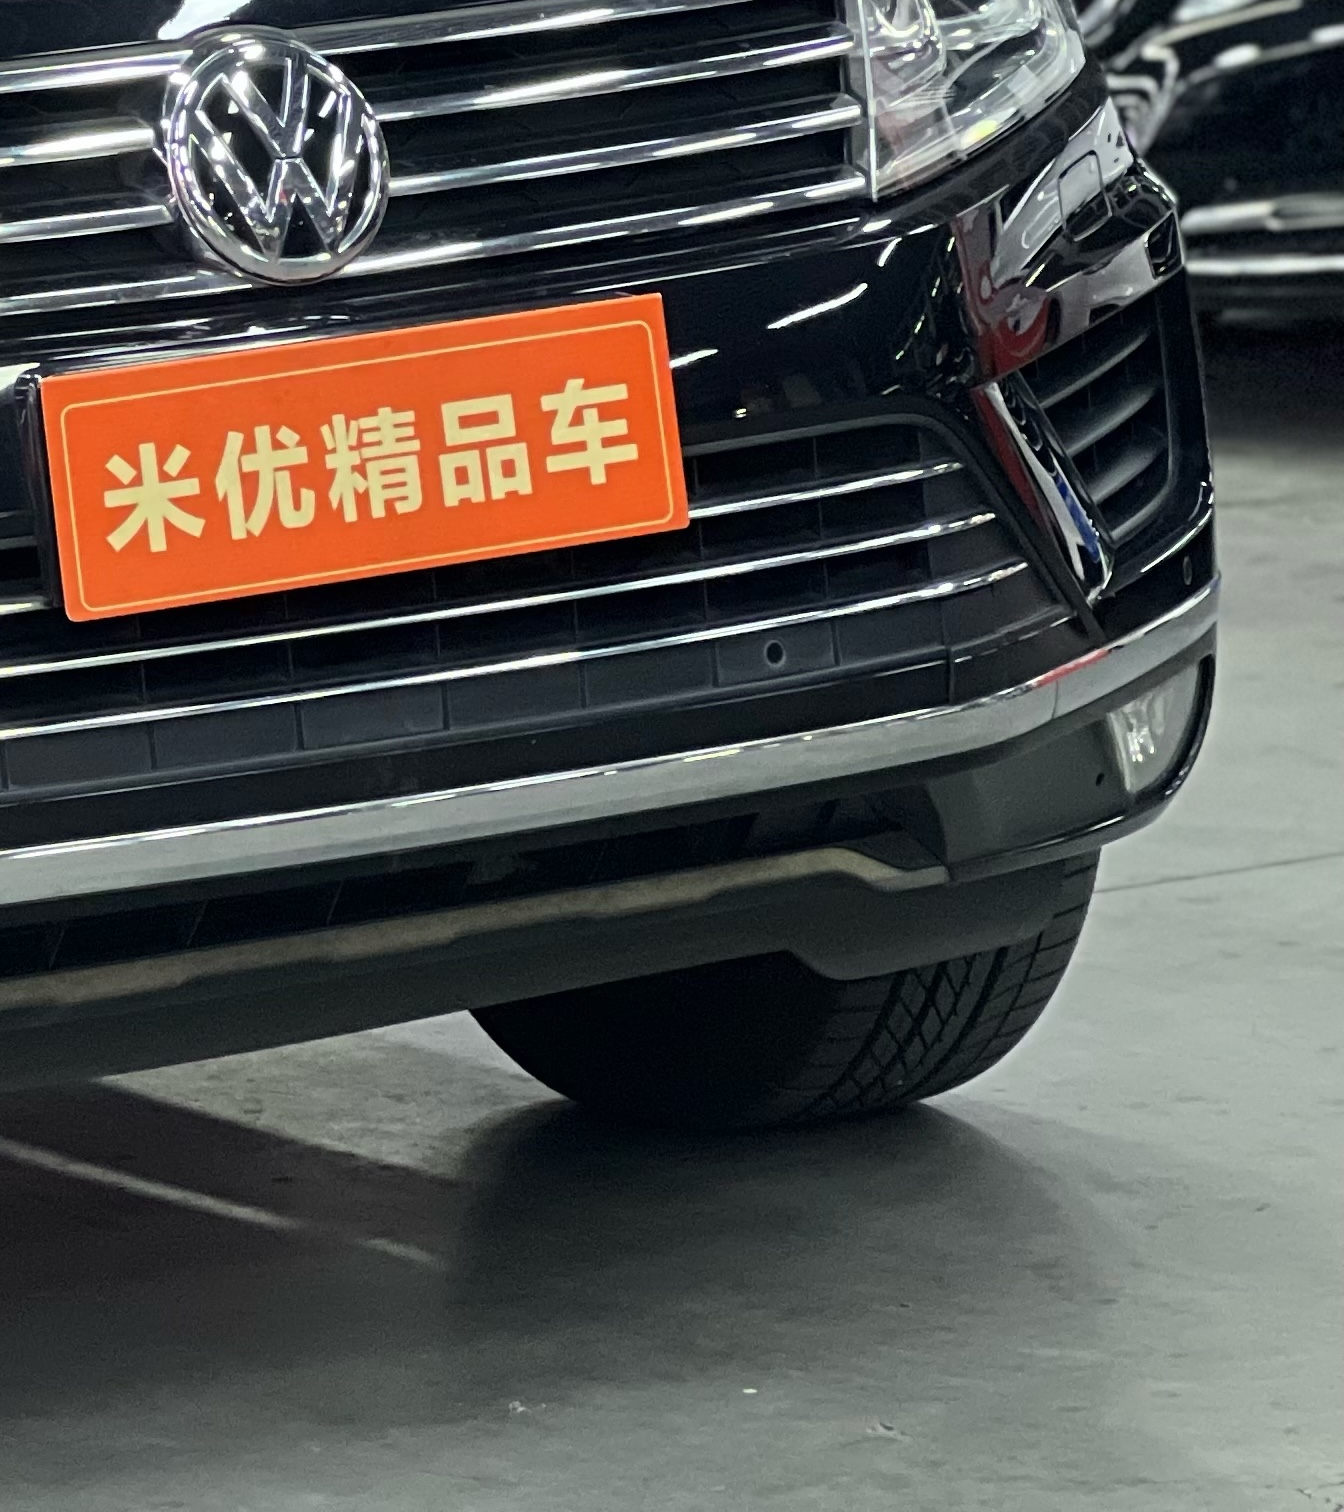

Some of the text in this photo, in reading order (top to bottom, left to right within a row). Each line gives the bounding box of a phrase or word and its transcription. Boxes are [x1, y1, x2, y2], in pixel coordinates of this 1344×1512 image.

[104, 378, 640, 553] 米优精品车
